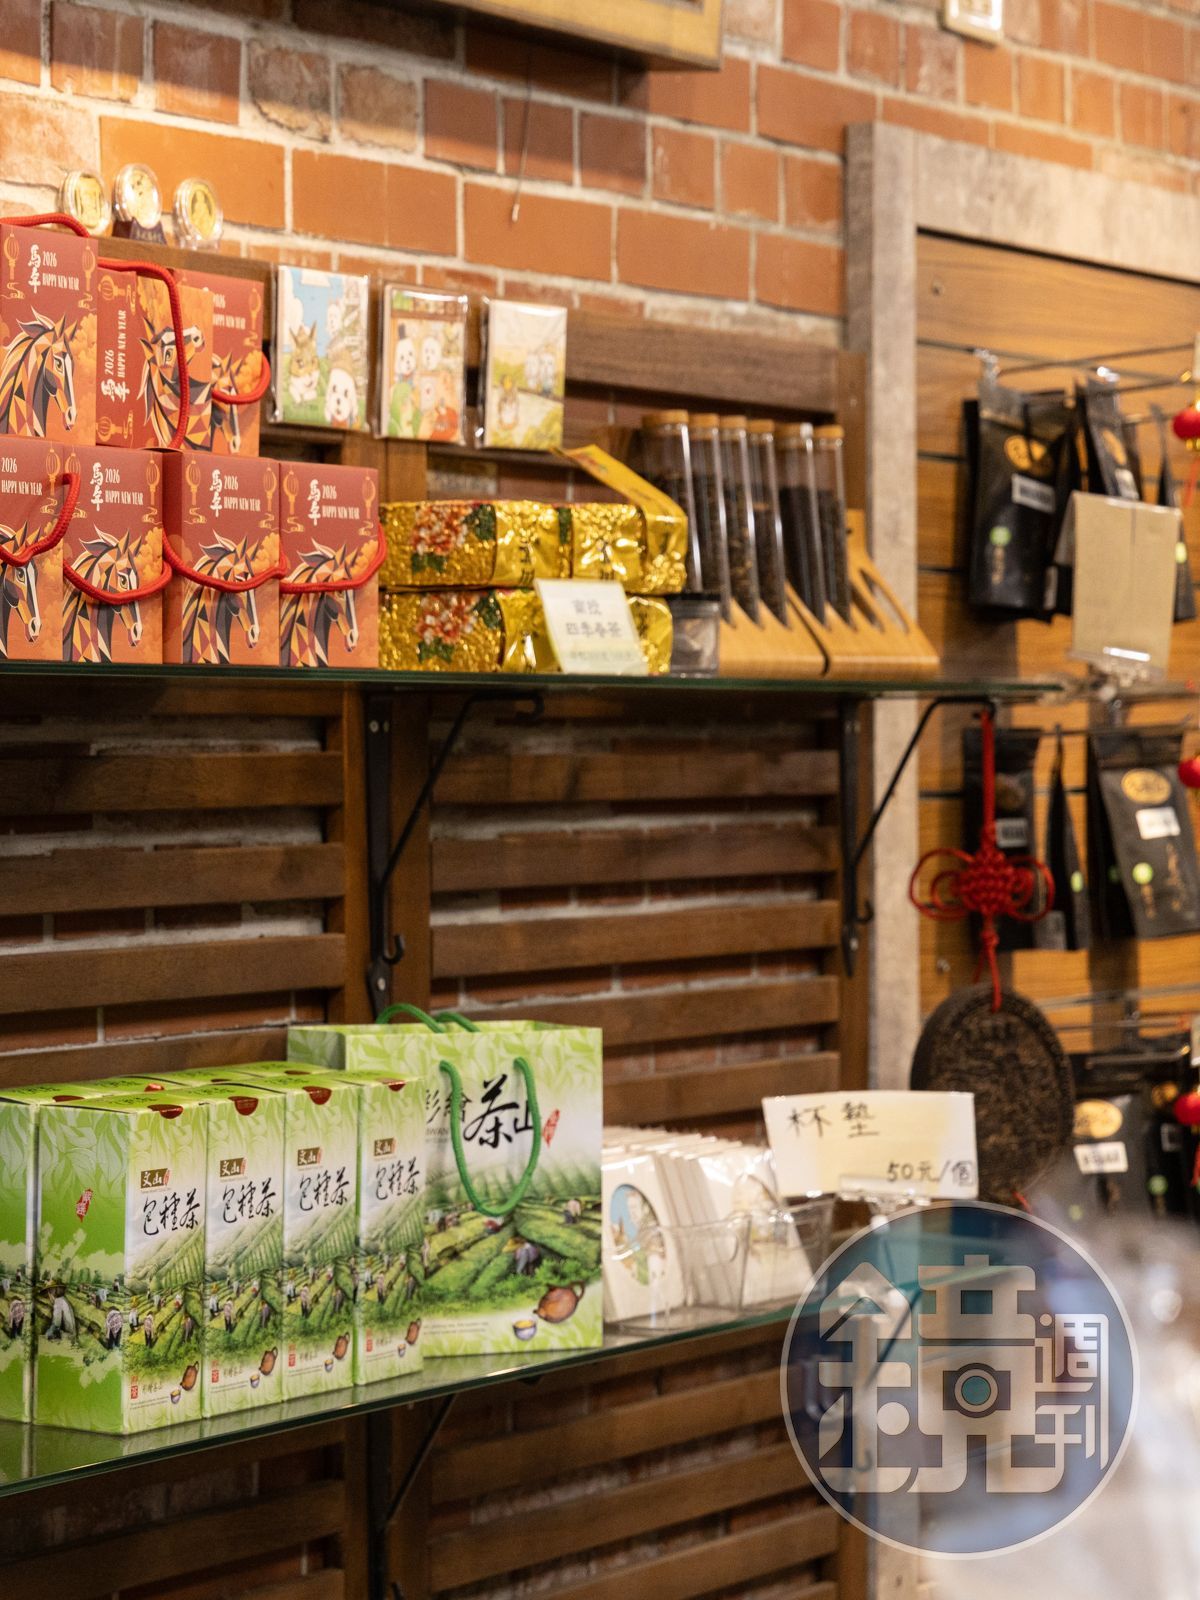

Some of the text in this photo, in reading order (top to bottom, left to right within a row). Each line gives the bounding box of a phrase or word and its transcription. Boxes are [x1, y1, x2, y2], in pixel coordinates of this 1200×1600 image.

[42, 251, 57, 267] 2026
[28, 244, 41, 294] 馬年
[42, 273, 79, 290] HAPPY NEW YEAR
[118, 310, 126, 377] HAPPY NEW YEAR
[105, 349, 114, 375] 2026
[101, 379, 129, 402] 馬年
[2, 457, 17, 473] 2026
[105, 468, 120, 484] 2026
[224, 476, 238, 490] 2026
[1, 480, 42, 496] HAPPY NEW YEAR
[90, 462, 103, 511] 馬年
[210, 470, 222, 517] 馬年
[322, 485, 337, 499] 2026
[105, 490, 143, 505] HAPPY NEW YEAR
[224, 496, 260, 512] HAPPY NEW YEAR
[308, 479, 321, 526] 馬年
[322, 506, 359, 520] HAPPY NEW YEAR
[789, 1102, 880, 1139] 杯墊
[298, 1150, 317, 1164] 文山
[222, 1160, 240, 1176] 文山
[142, 1171, 163, 1187] 文山
[376, 1157, 420, 1200] 包種茶
[299, 1166, 350, 1211] 包種茶
[223, 1177, 276, 1224] 包種茶
[143, 1188, 201, 1236] 包種茶
